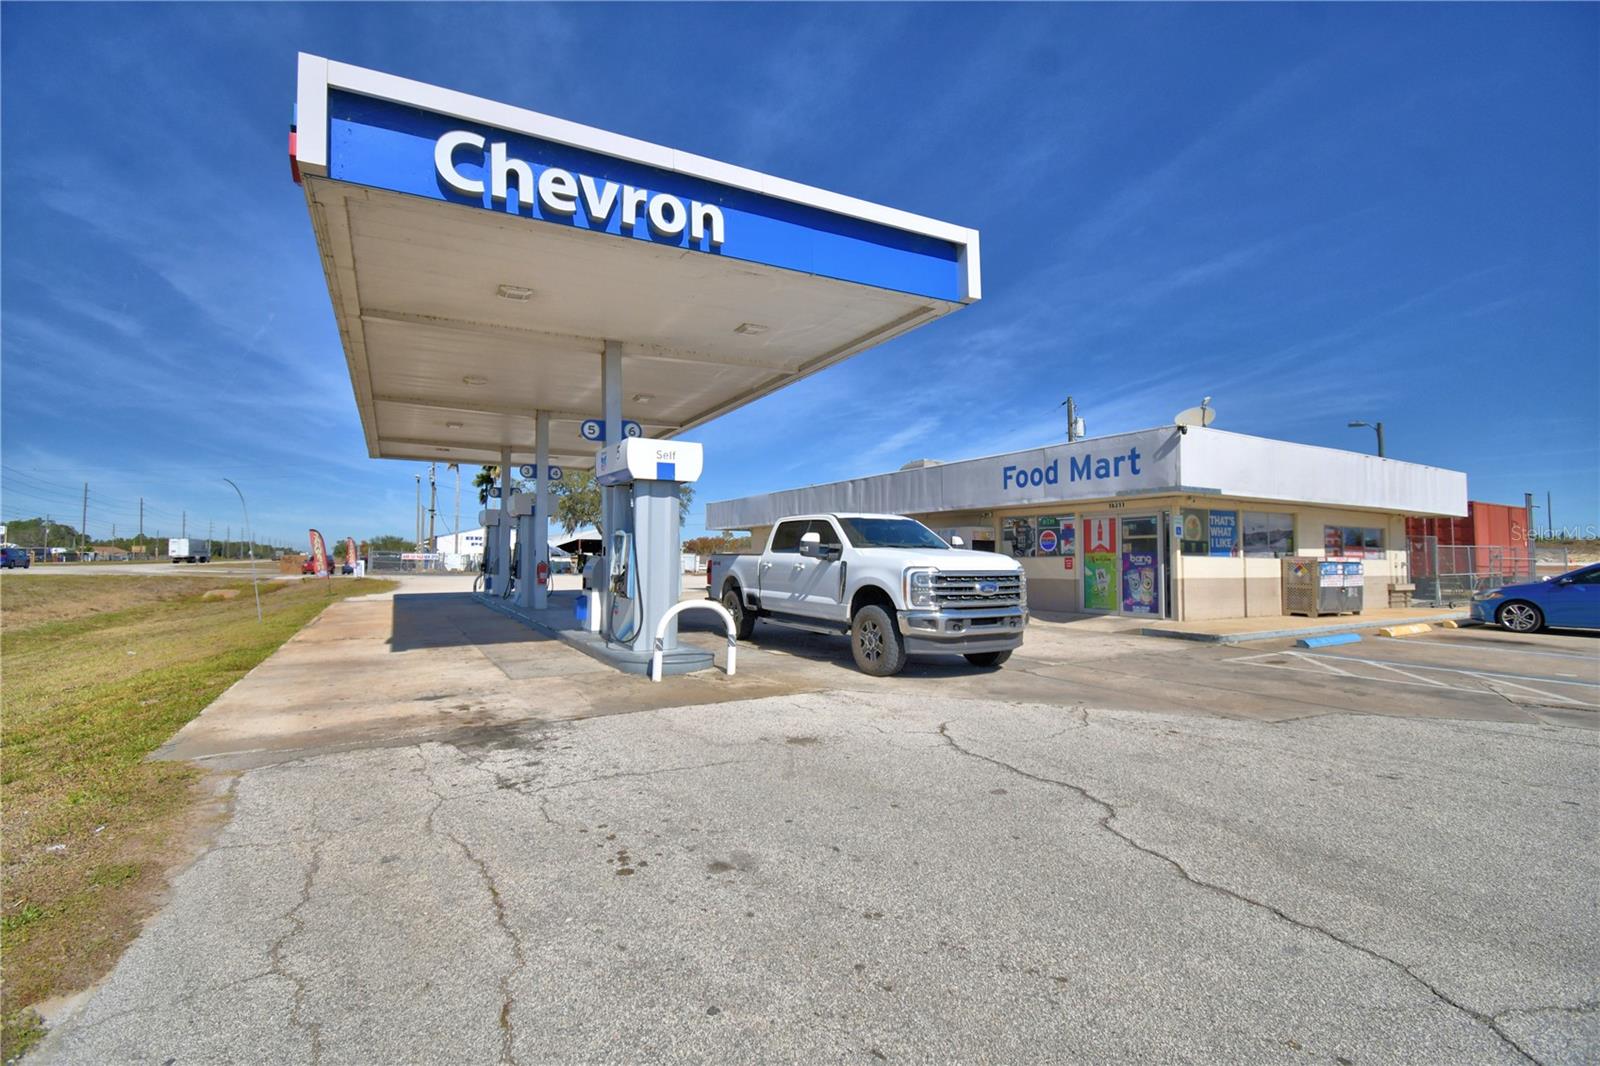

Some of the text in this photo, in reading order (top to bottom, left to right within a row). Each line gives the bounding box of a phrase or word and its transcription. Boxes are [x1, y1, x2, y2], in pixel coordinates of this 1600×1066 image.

[434, 130, 725, 246] Chevron
[588, 425, 596, 435] 5
[628, 427, 636, 437] 6
[656, 450, 676, 460] Self
[1003, 447, 1141, 490] Food Mart
[1210, 527, 1232, 537] WHAT
[1216, 538, 1232, 548] LIKE
[1130, 554, 1152, 564] bang
